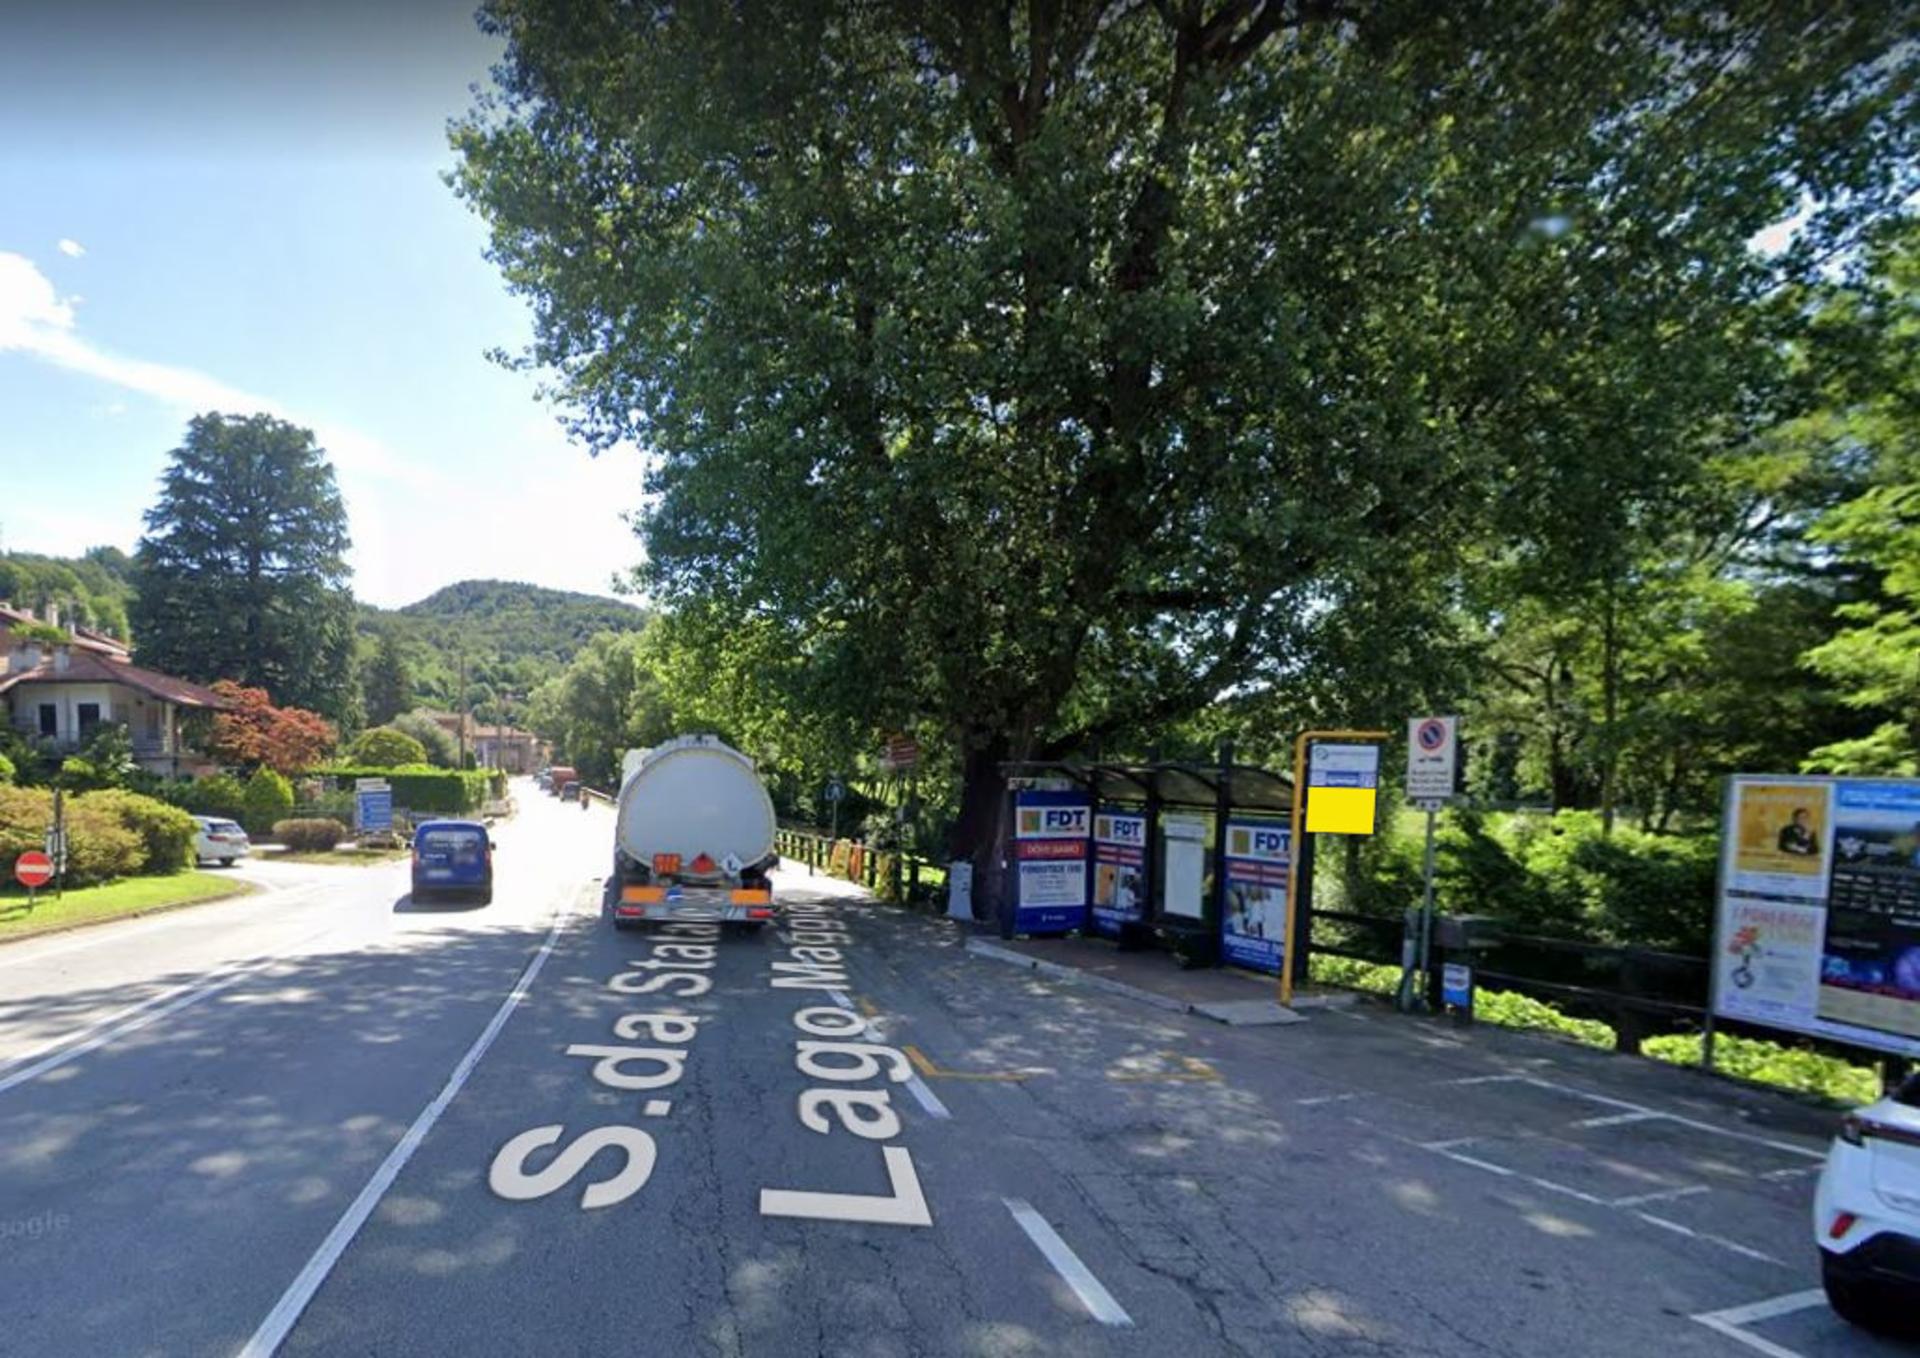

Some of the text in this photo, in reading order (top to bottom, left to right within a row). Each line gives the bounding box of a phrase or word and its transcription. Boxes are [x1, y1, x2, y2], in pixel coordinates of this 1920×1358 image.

[1046, 810, 1086, 827] FDT
[1113, 819, 1142, 837] FDT
[1254, 831, 1290, 852] FDT
